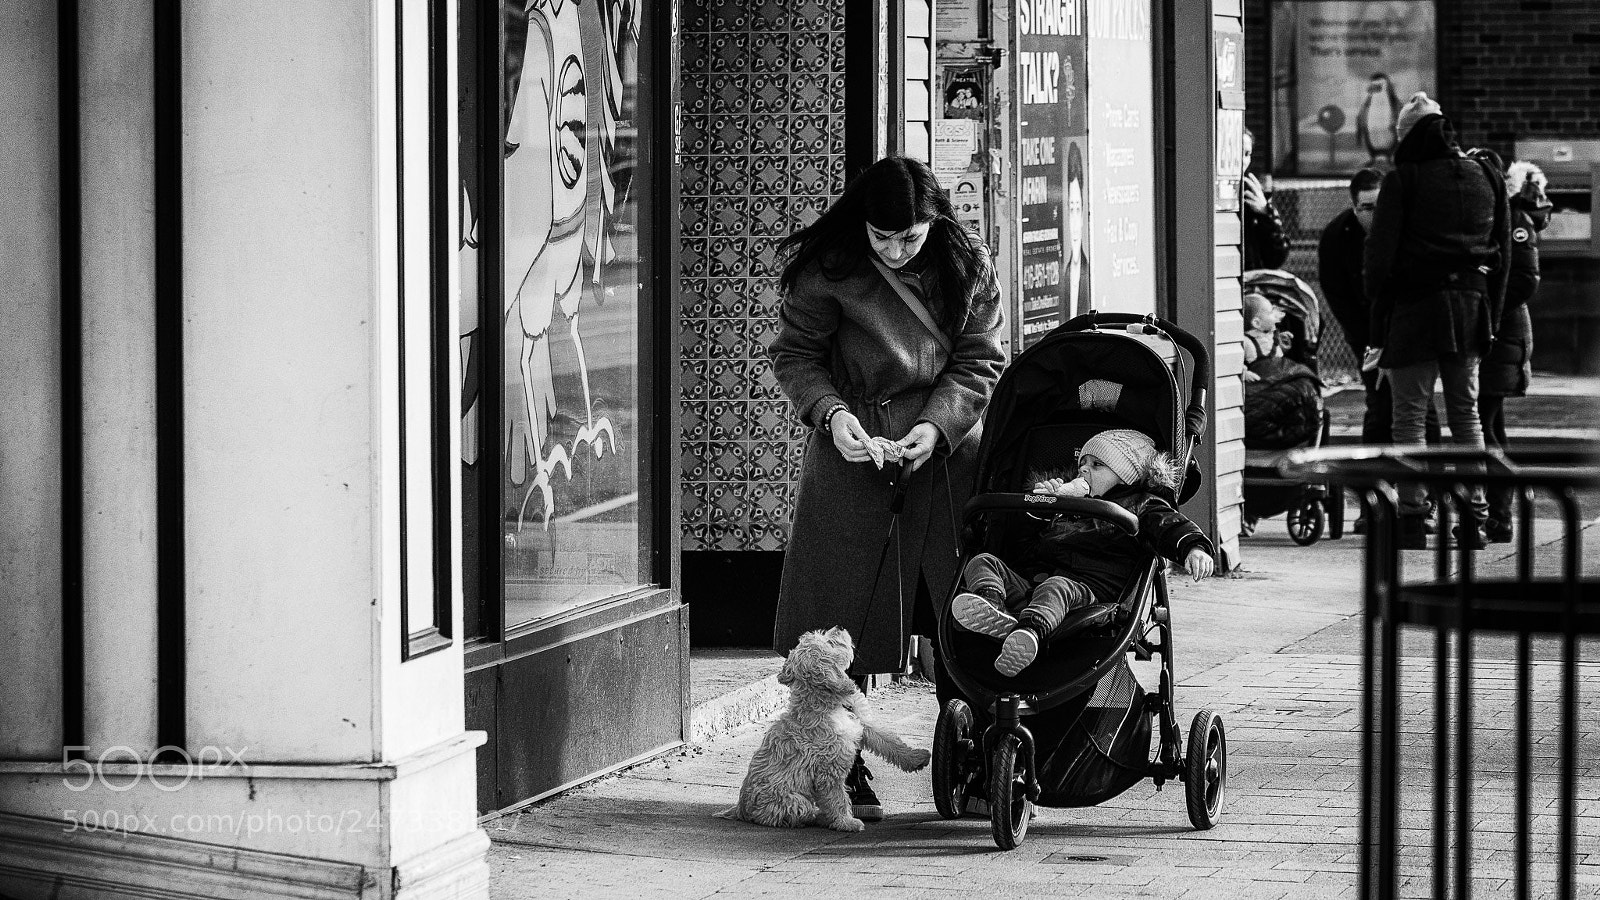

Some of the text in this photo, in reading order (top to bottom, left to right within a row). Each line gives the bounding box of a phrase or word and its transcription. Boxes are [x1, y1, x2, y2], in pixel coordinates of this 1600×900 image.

[1020, 0, 1081, 36] STRAIGHT
[1020, 51, 1060, 104] TALK?
[1022, 136, 1056, 166] TAKE ONE
